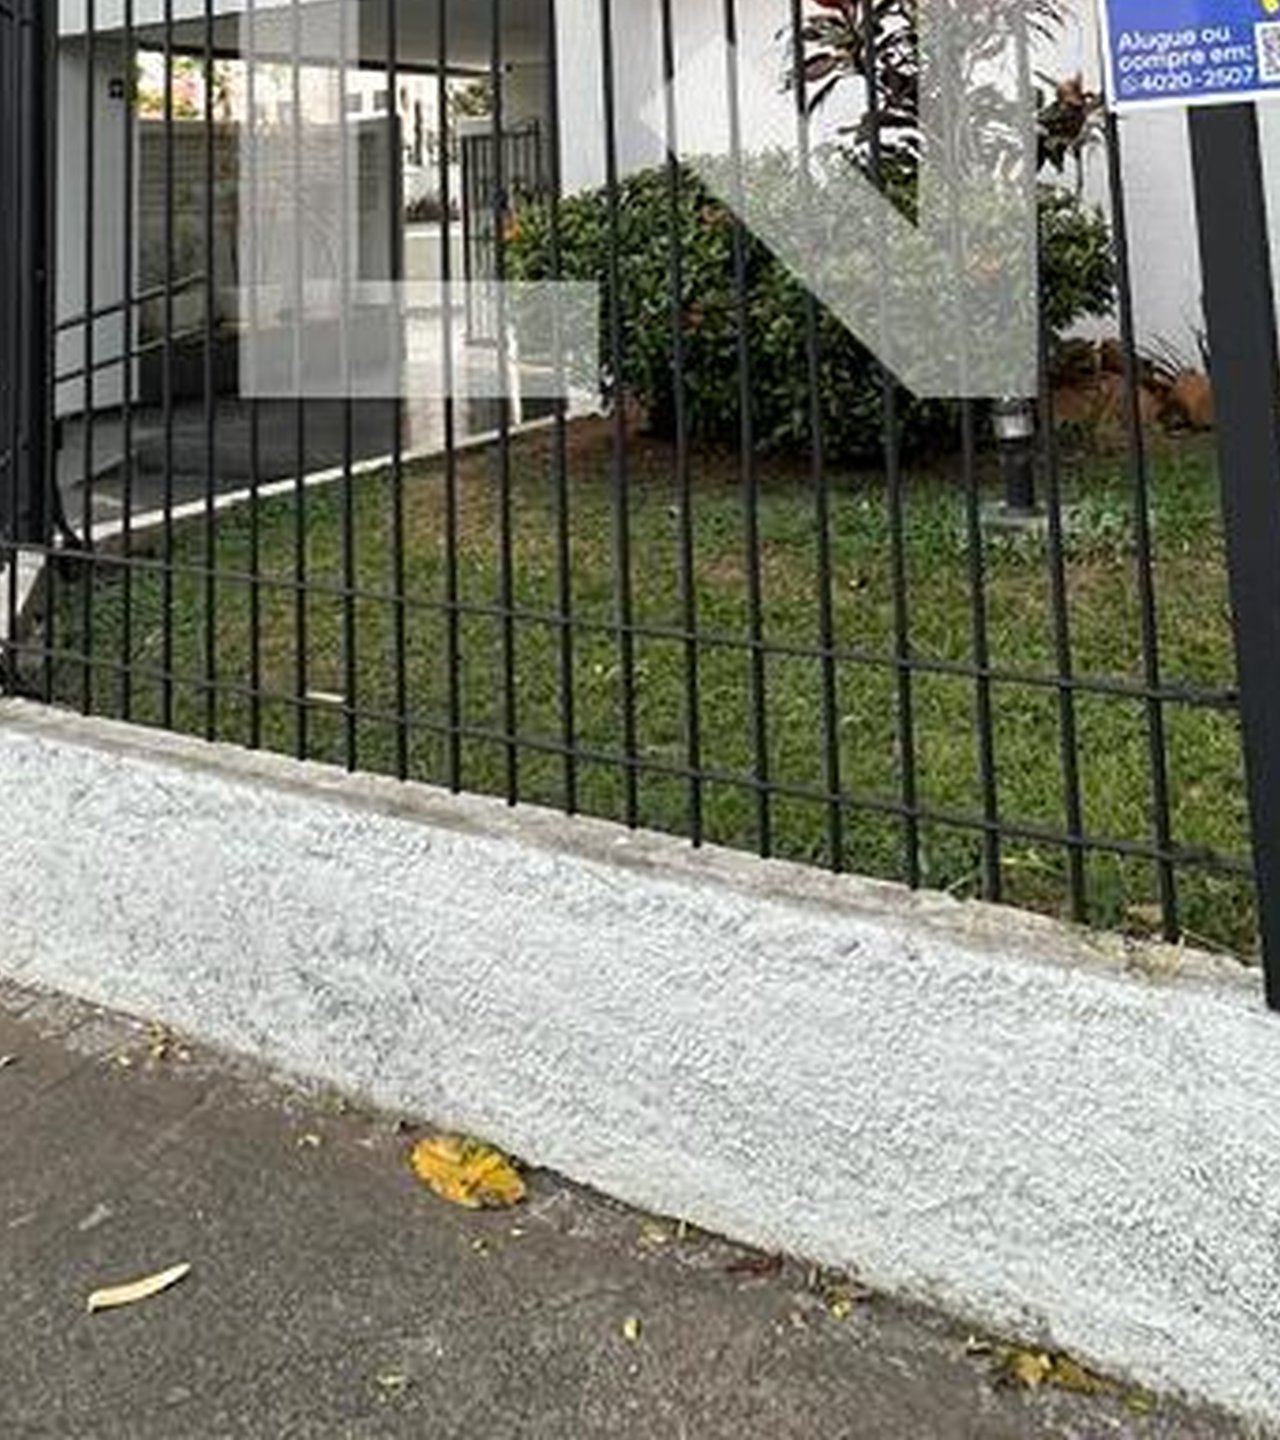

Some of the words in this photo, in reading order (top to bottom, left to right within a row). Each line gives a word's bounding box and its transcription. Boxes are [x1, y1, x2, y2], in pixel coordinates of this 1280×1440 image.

[1118, 29, 1196, 53] Alugue
[1201, 26, 1230, 43] ou
[1119, 50, 1206, 75] compre
[1209, 44, 1253, 64] em:
[1140, 65, 1254, 92] 4020-2507
